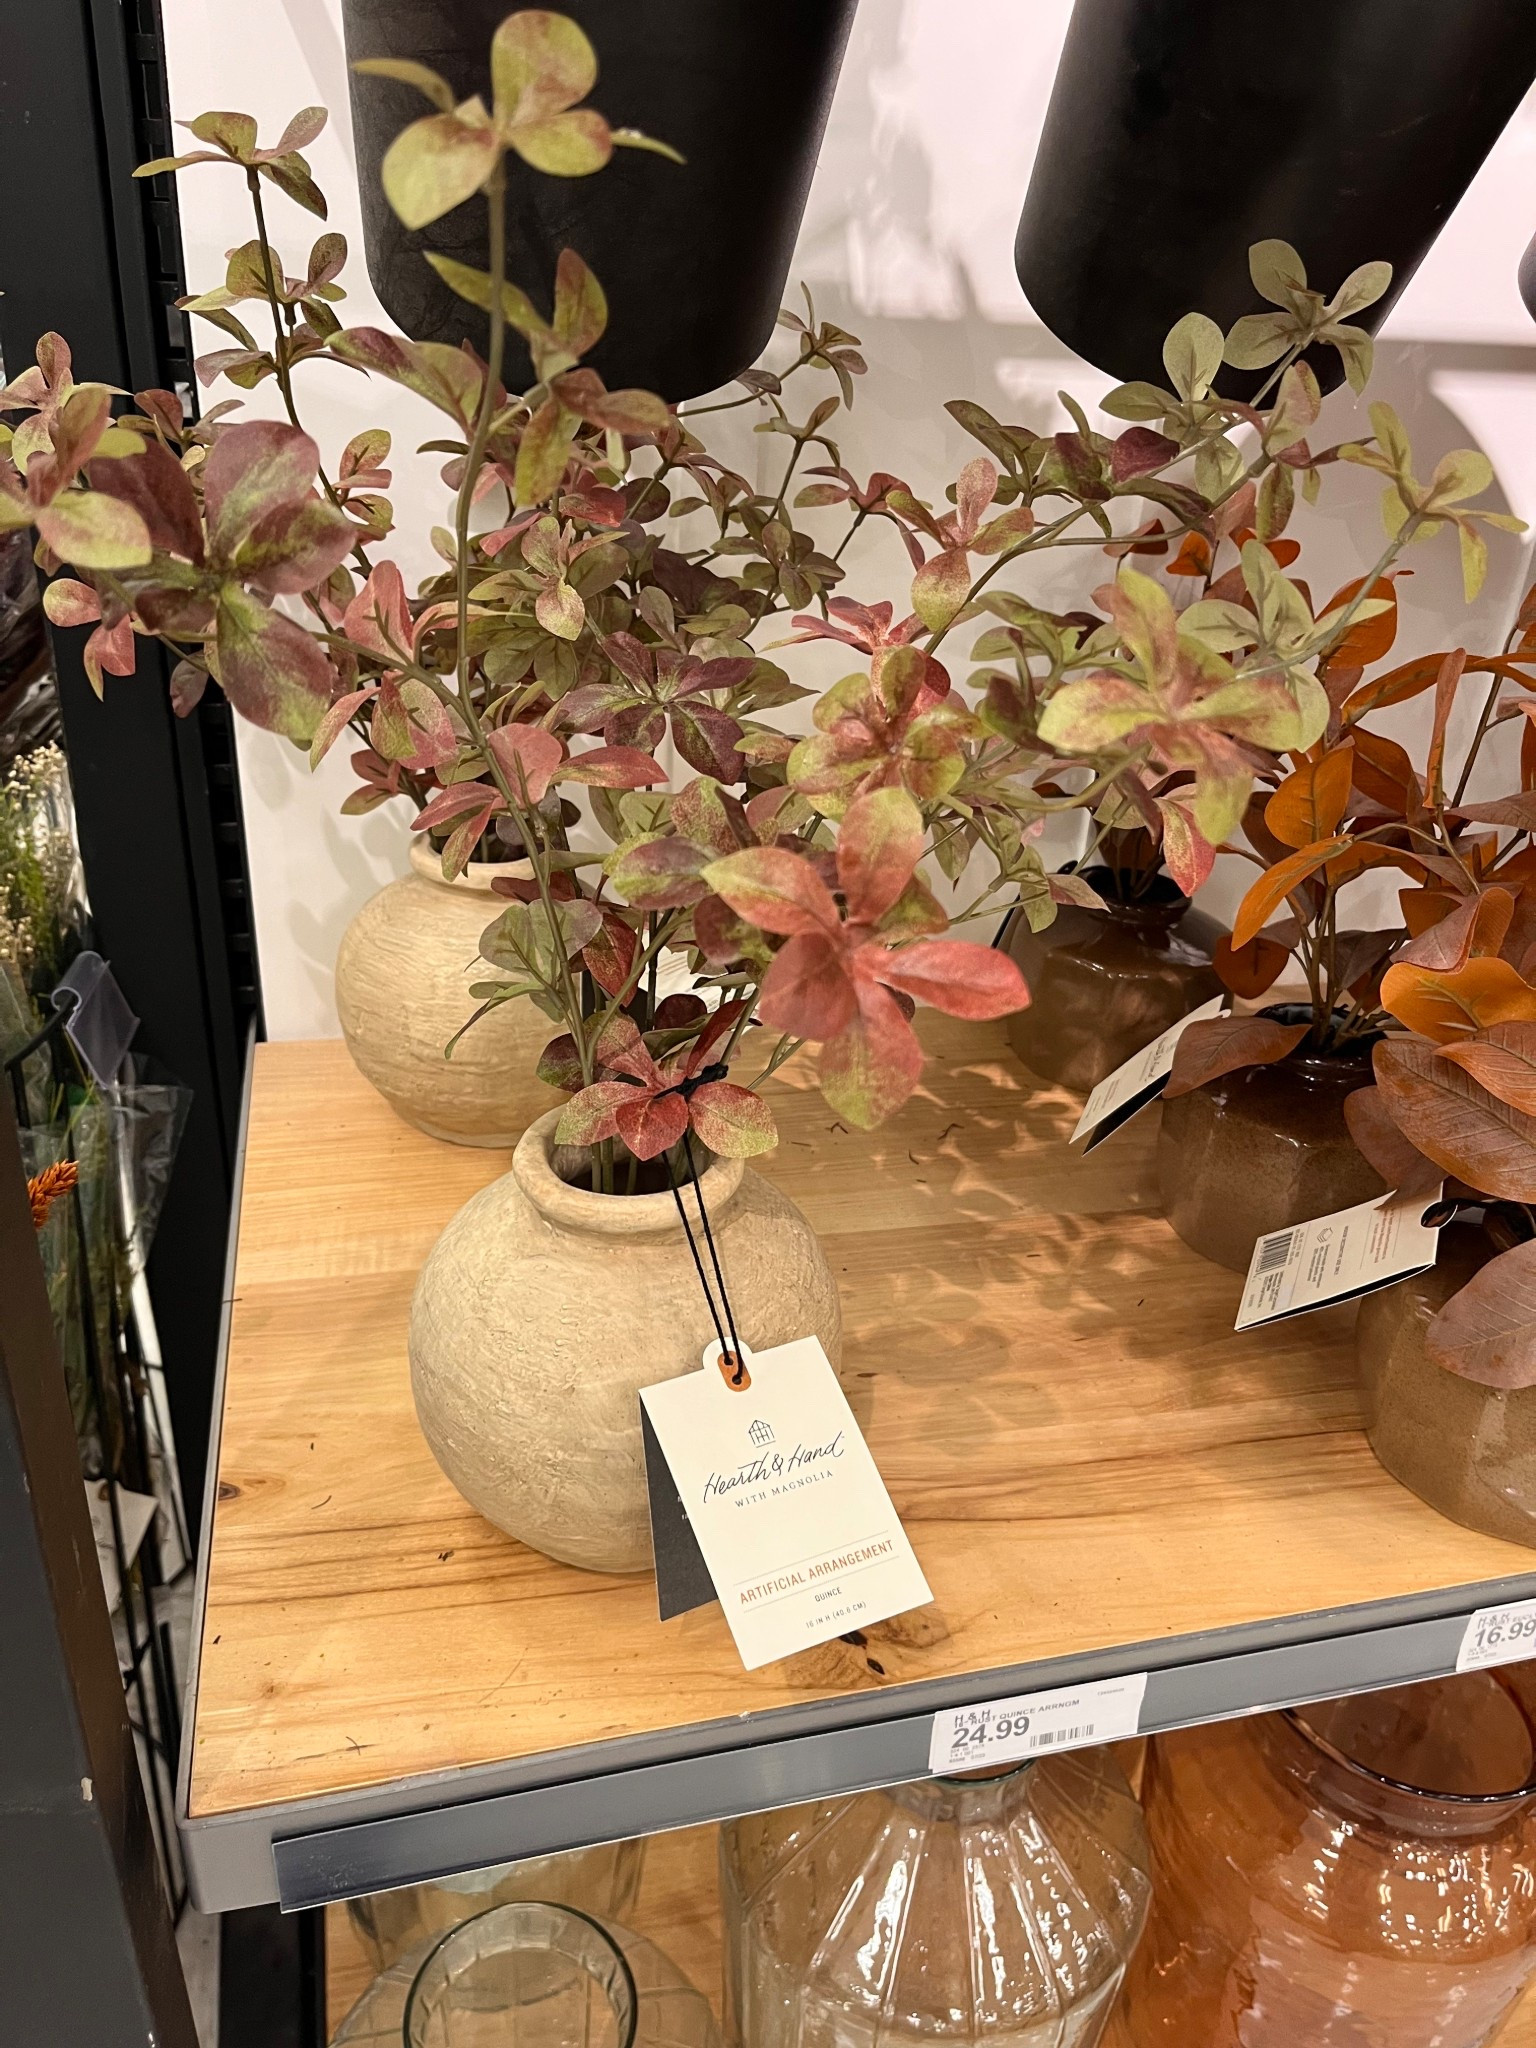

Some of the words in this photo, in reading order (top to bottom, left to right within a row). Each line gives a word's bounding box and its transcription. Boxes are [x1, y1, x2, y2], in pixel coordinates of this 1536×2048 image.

[703, 1451, 771, 1504] Hearth
[771, 1453, 784, 1476] &
[788, 1430, 845, 1473] Hand
[735, 1491, 767, 1508] WITH
[771, 1470, 834, 1496] MAGNOLIA
[739, 1571, 807, 1605] ARTIFICIAL
[808, 1539, 895, 1581] ARRANGEMENT
[814, 1586, 843, 1603] QUINCE
[805, 1620, 814, 1629] 16
[1475, 1619, 1536, 1647] 16.99
[999, 1708, 1036, 1720] QUINCE
[1037, 1699, 1080, 1713] ARRNGM
[950, 1716, 1030, 1749] 24.99
